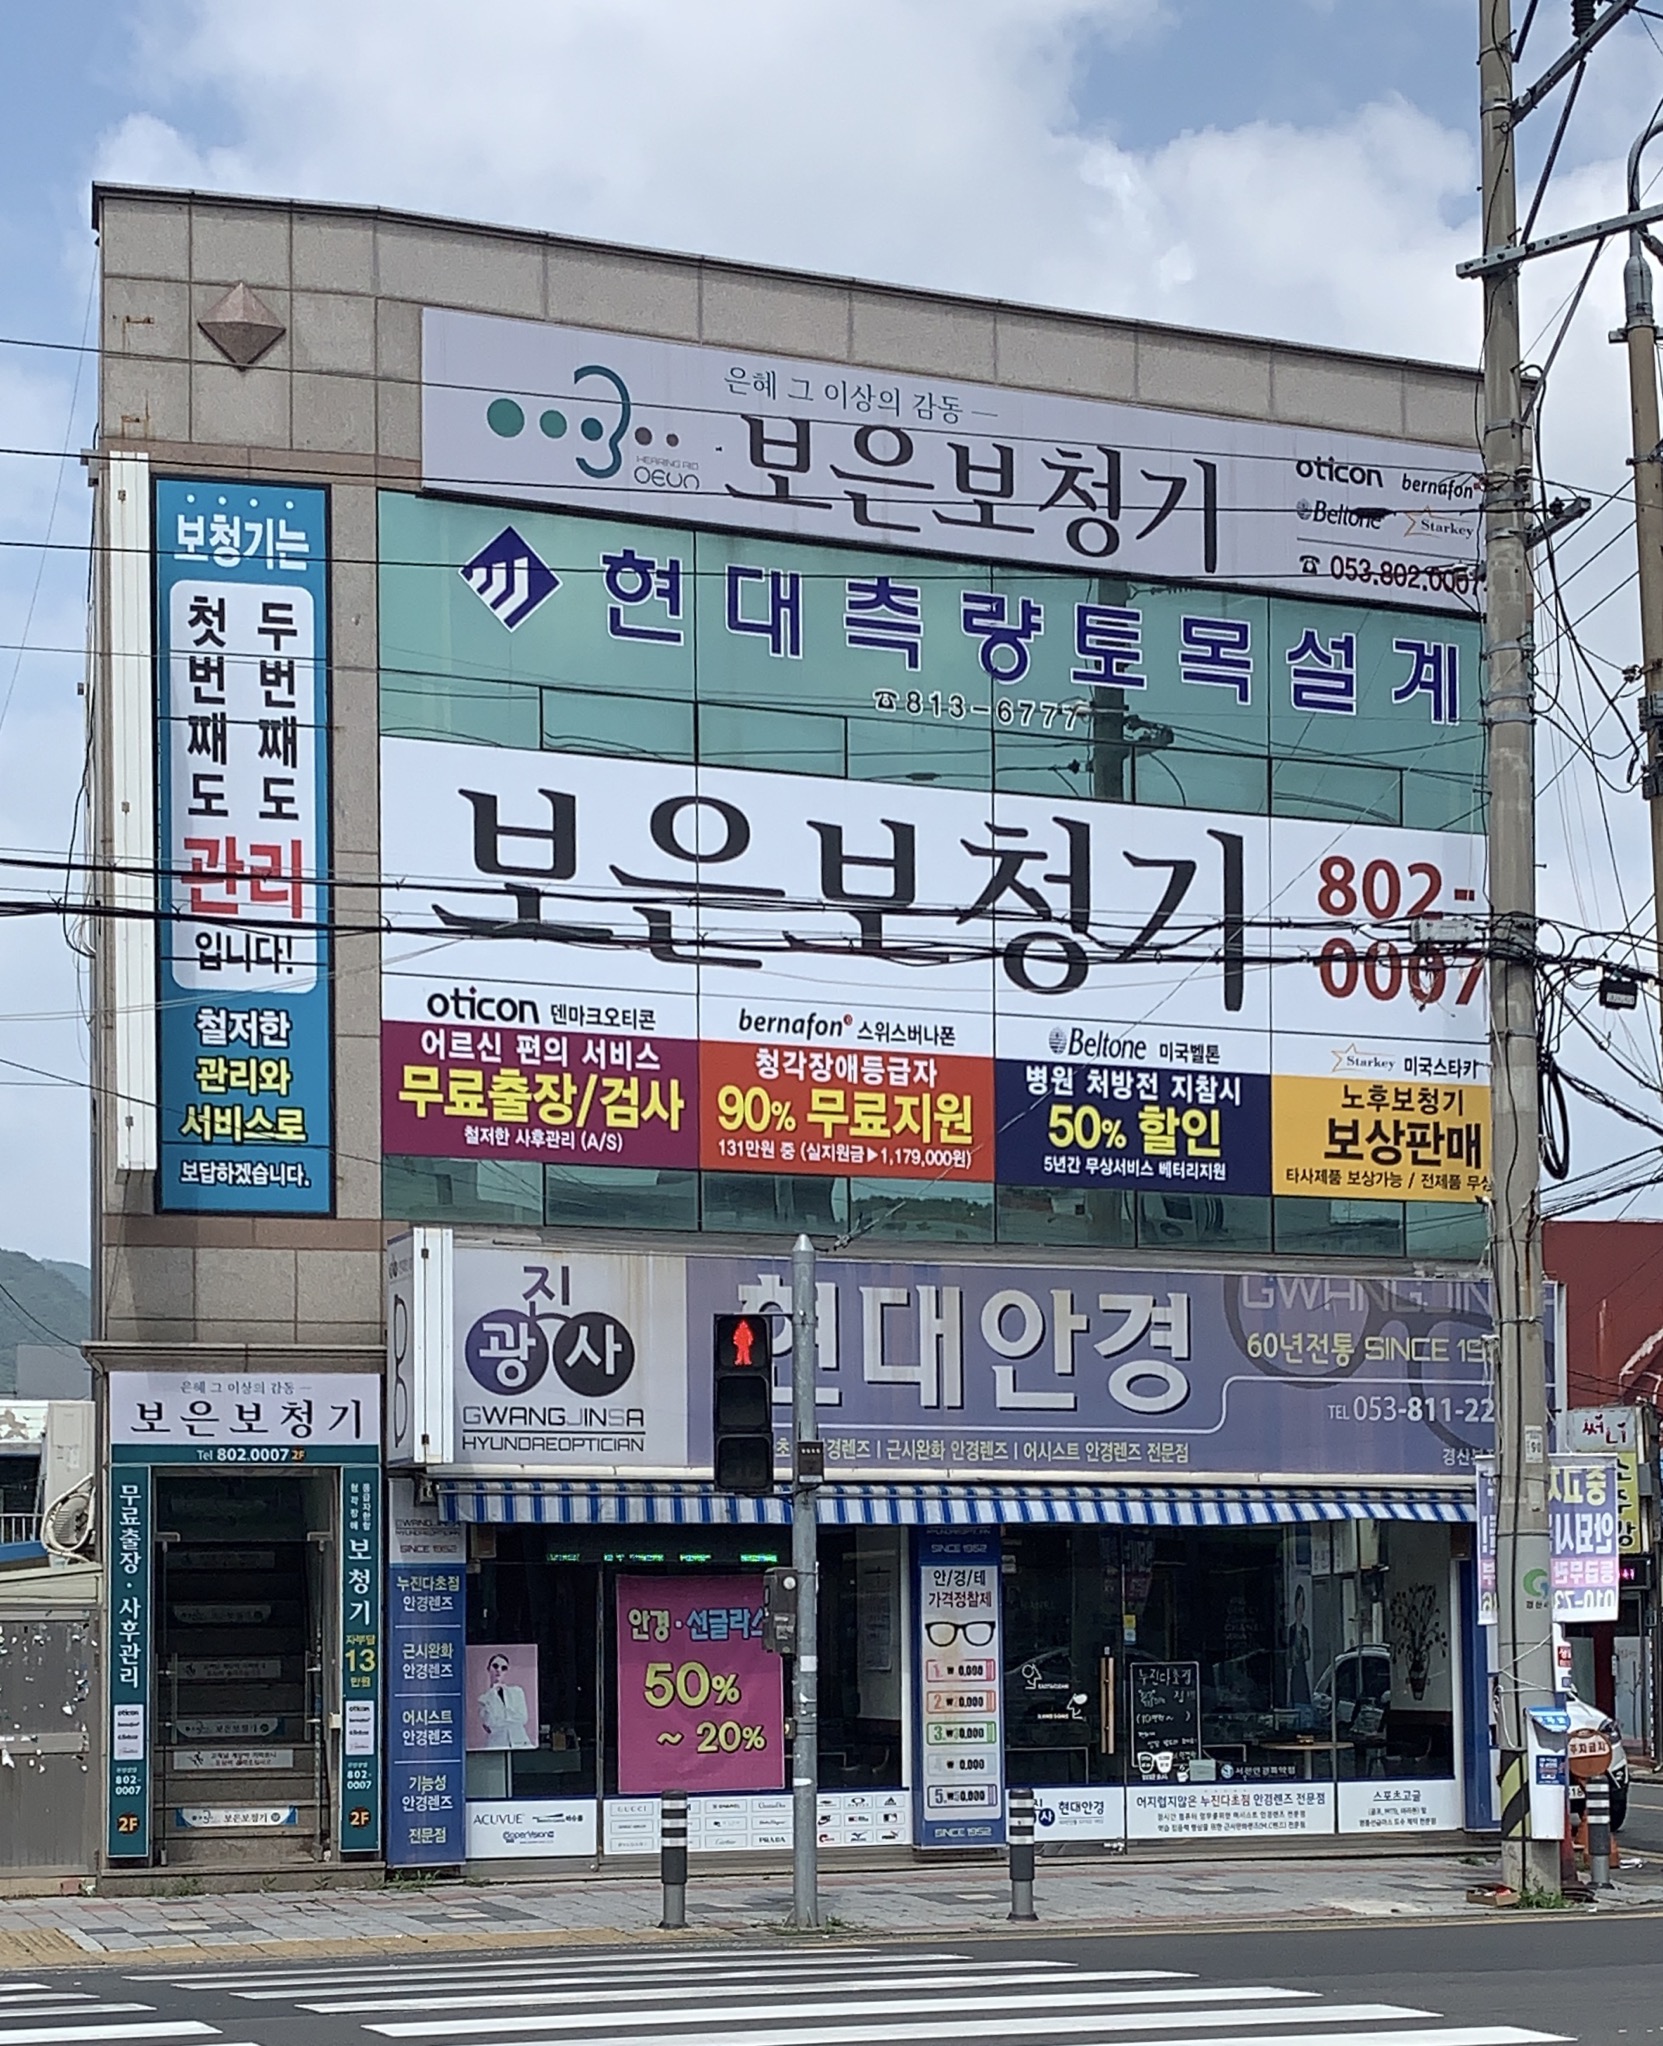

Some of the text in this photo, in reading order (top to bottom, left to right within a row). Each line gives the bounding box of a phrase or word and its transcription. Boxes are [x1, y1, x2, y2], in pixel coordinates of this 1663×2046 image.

[724, 366, 963, 424] 은혜 그 이상의 감동
[1296, 456, 1473, 500] oticon bernafon
[725, 414, 1218, 574] 보은보청기
[1420, 518, 1474, 539] Starkey
[174, 513, 310, 571] 보청기는
[905, 690, 1079, 732] 813-6777
[181, 836, 304, 919] 관리
[1318, 855, 1475, 919] 802-
[431, 787, 1245, 1013] 보은보청기
[196, 931, 294, 974] 입니다!
[427, 986, 540, 1024] oticon
[196, 1008, 292, 1048] 철저한
[551, 1003, 656, 1031] 덴마크오티콘
[738, 1008, 843, 1040] bernafon
[421, 1028, 660, 1072] 어르신 편의 서비스
[1068, 1027, 1147, 1060] Beltone
[1159, 1042, 1220, 1064] 미국벨톤
[756, 1047, 938, 1088] 청각장애등급자
[1347, 1054, 1396, 1072] Starkey
[196, 1056, 292, 1097] 관리와
[1026, 1065, 1241, 1106] 병원 처방전 지참시
[399, 1064, 685, 1131] 무료출장/검사
[1341, 1084, 1464, 1116] 노후보청기
[180, 1104, 307, 1144] 서비스로
[717, 1084, 973, 1144] 90% 무료지원
[464, 1124, 623, 1153] 철저한 사후관리 (A/S)
[1049, 1104, 1221, 1157] 50% 할인
[718, 1138, 796, 1161] 131만원 중
[1324, 1118, 1482, 1169] 보상판매
[180, 1160, 311, 1188] 보답하겠습니다.
[1044, 1155, 1226, 1181] 5년간 무상서비스 베터리지원
[1286, 1167, 1342, 1184] 타사제품
[1347, 1170, 1403, 1189] 보상가능
[1421, 1173, 1461, 1190] 전제품
[1247, 1331, 1449, 1367] 60년전통 SINCE
[180, 1381, 205, 1395] 은혜
[211, 1382, 222, 1393] 그
[228, 1381, 265, 1395] 이상의
[130, 1399, 361, 1439] 보은보청기
[463, 1406, 645, 1427] GWANGJINSA
[1328, 1404, 1349, 1420] TEL
[197, 1447, 305, 1462] Tel 802.0007 2F
[823, 1440, 870, 1460] 경렌즈
[886, 1440, 1008, 1462] 근시완화 안경렌즈
[1023, 1441, 1189, 1464] 어시스트 안경렌즈 전문점
[347, 1538, 373, 1627] 보청기
[396, 1576, 460, 1592] 누진다초점
[933, 1569, 986, 1587] 안/경/테
[403, 1596, 453, 1612] 안경렌즈
[928, 1590, 992, 1609] 가격정찰제
[628, 1608, 671, 1641] 안경
[346, 1634, 376, 1646] 자부담
[402, 1643, 453, 1659] 근시완화
[345, 1649, 376, 1672] 13
[402, 1663, 453, 1679] 안경렌즈
[351, 1677, 372, 1688] 만원
[643, 1661, 742, 1709] 50%
[402, 1710, 453, 1726] 어시스트
[402, 1730, 453, 1746] 안경렌즈
[696, 1721, 768, 1753] 20%
[1569, 1741, 1606, 1754] 주차금지
[115, 1775, 141, 1784] 802-
[347, 1770, 372, 1779] 802-
[347, 1780, 372, 1790] 0007
[409, 1775, 447, 1791] 기능성
[115, 1785, 141, 1795] 0007
[1136, 1792, 1325, 1809] 어지럽지않은 누진다초점 안경렌즈 전문점
[1373, 1790, 1421, 1801] 스포츠고글
[402, 1796, 453, 1812] 안경렌즈
[1058, 1800, 1104, 1815] 현대안경
[118, 1816, 138, 1831] 2F
[350, 1811, 369, 1826] 2F
[473, 1814, 523, 1825] ACUVUE
[408, 1828, 446, 1844] 전문점
